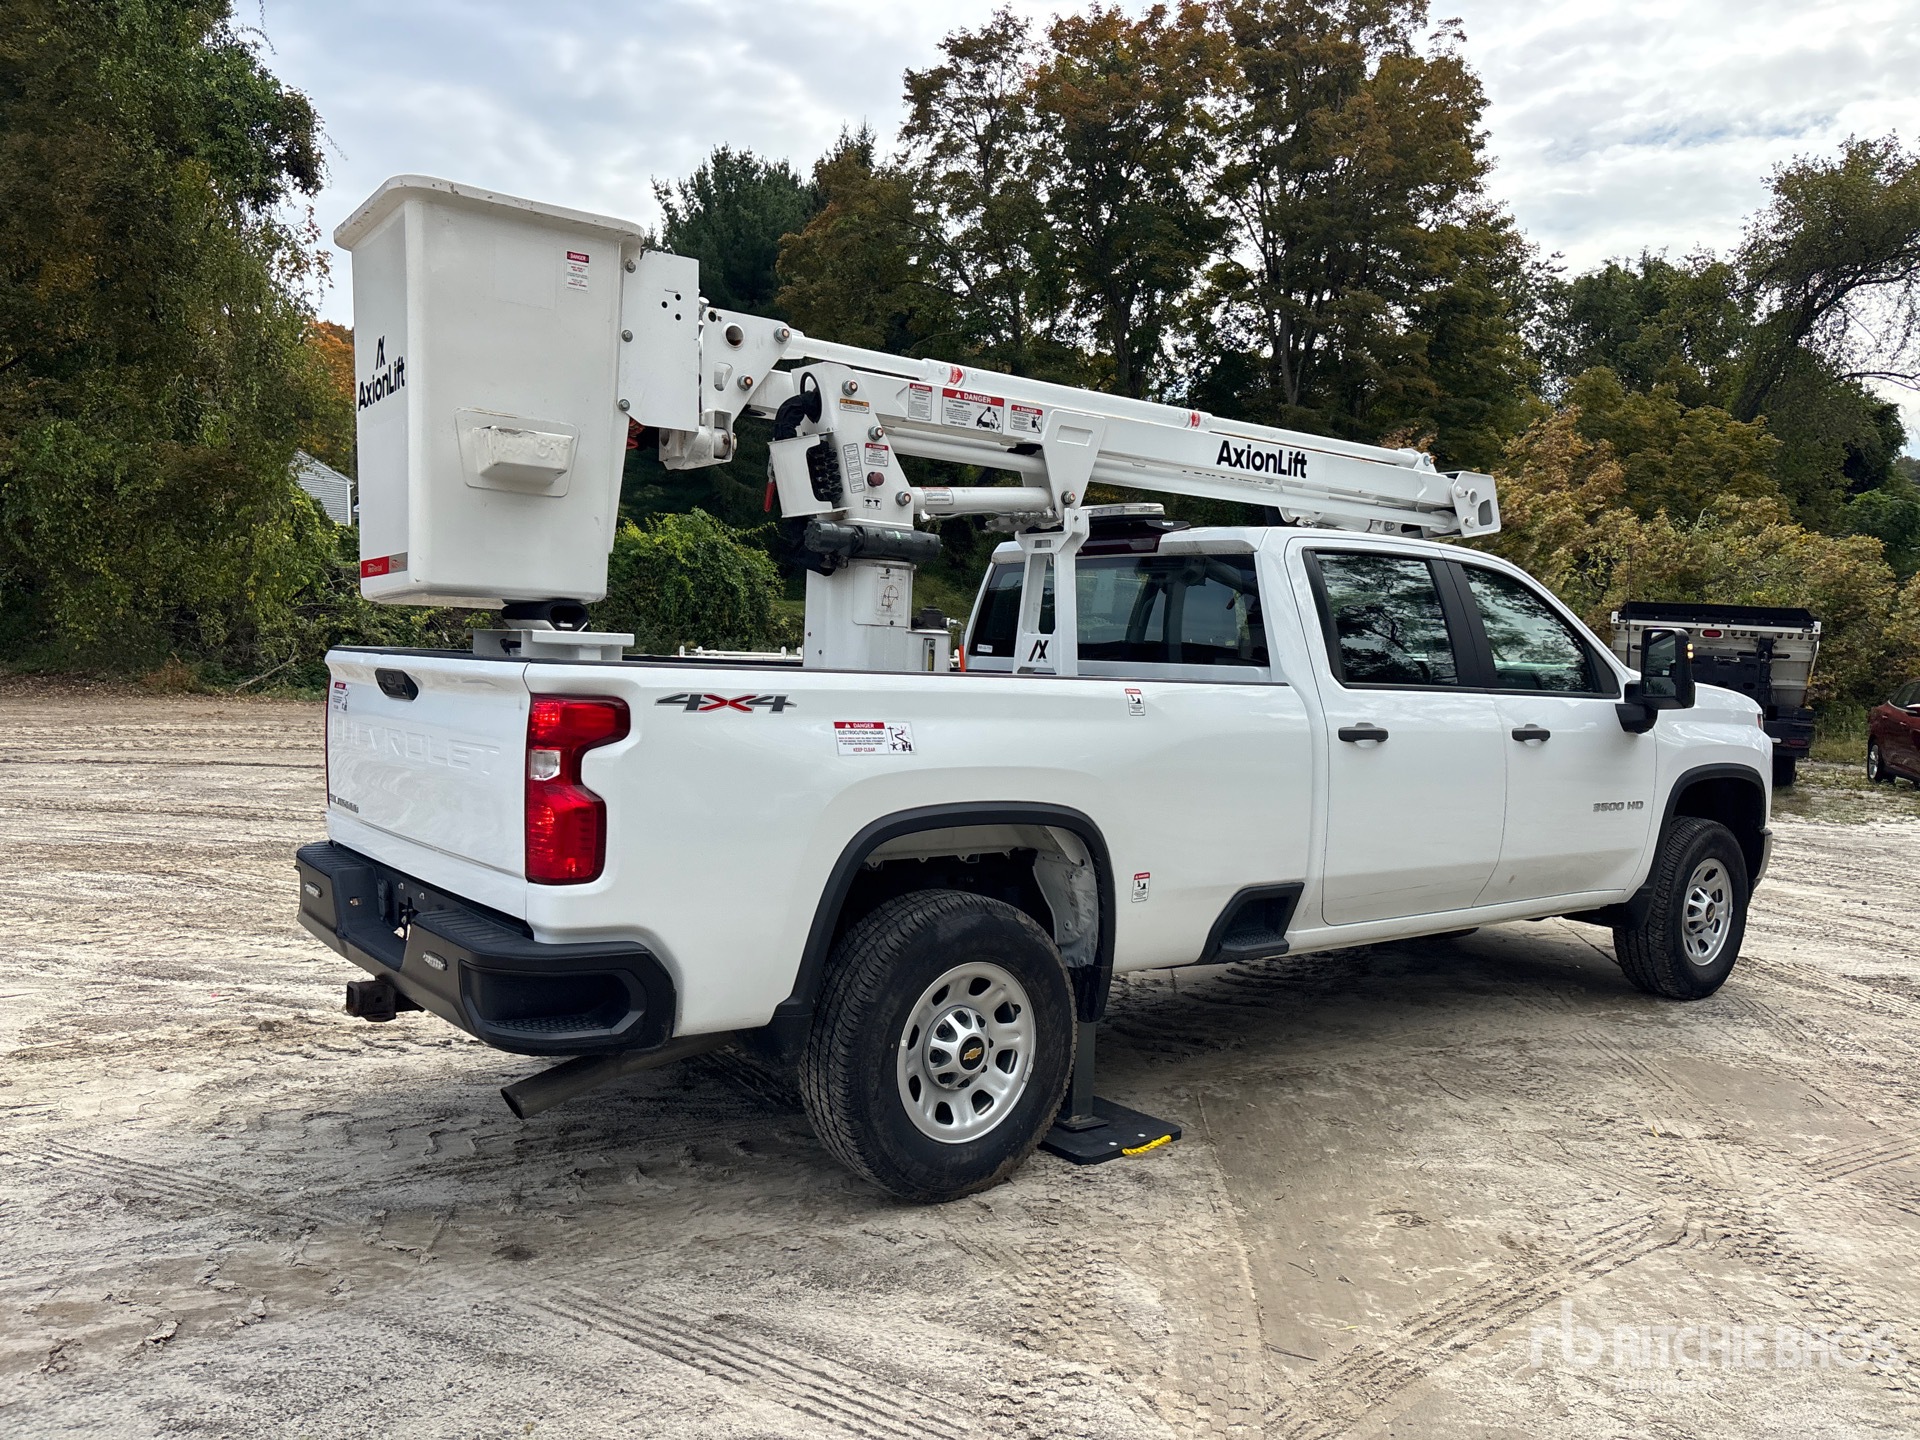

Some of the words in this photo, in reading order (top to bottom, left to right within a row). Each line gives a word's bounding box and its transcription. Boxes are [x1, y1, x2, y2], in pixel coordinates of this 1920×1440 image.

[358, 356, 405, 412] AxionLift
[963, 393, 992, 404] DANGER
[1216, 440, 1308, 479] AxionLift
[1593, 802, 1625, 812] 3500
[1627, 801, 1644, 810] HD
